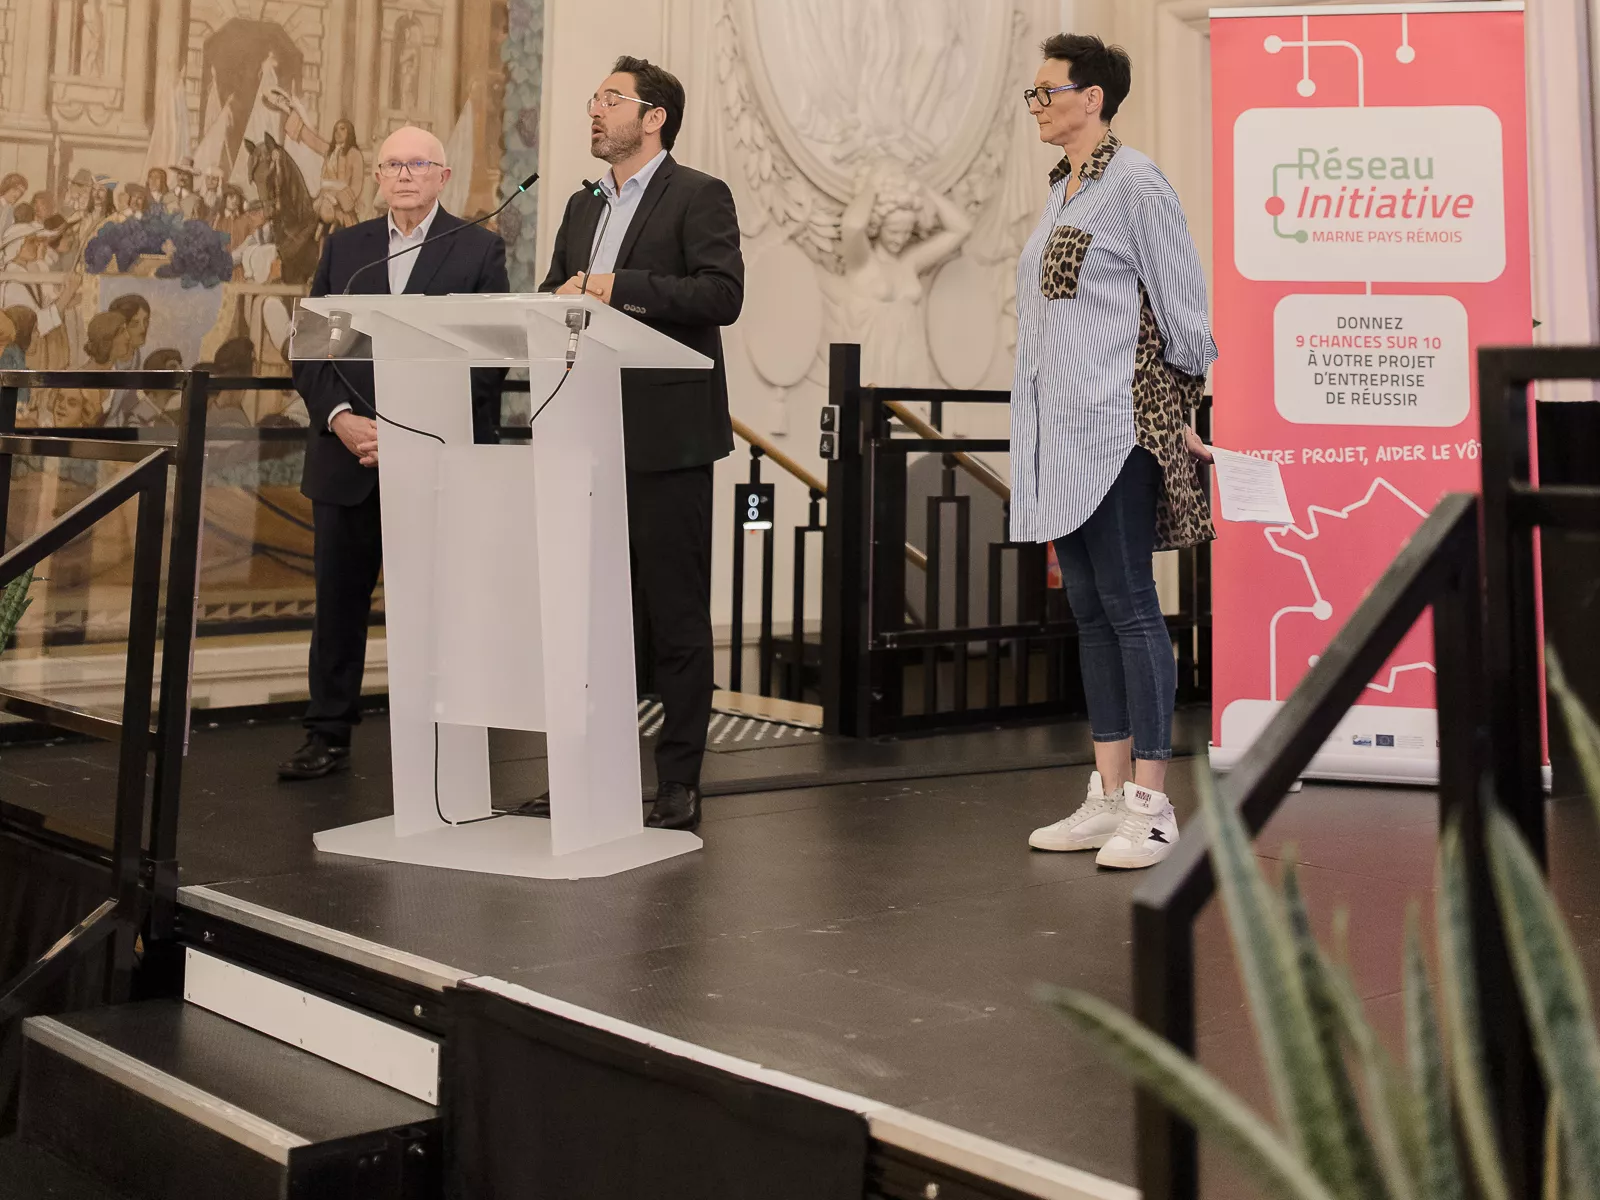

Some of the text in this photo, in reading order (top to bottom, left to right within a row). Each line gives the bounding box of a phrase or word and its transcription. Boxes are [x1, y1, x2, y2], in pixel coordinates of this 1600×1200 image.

[1298, 147, 1434, 180] Réseau
[1297, 186, 1474, 219] Initiative
[1312, 228, 1463, 243] MARNE PAYS RÉMOIS
[1337, 316, 1403, 330] DONNEZ
[1296, 335, 1441, 350] 9 CHANCES SUR 10
[1308, 350, 1435, 369] À VOTRE PROJET
[1314, 371, 1425, 387] D'ENTREPRISE
[1326, 388, 1417, 406] DE RÉUSSIR
[1302, 446, 1369, 466] PROJET,
[1375, 444, 1427, 463] AIDER
[1432, 444, 1451, 460] LE
